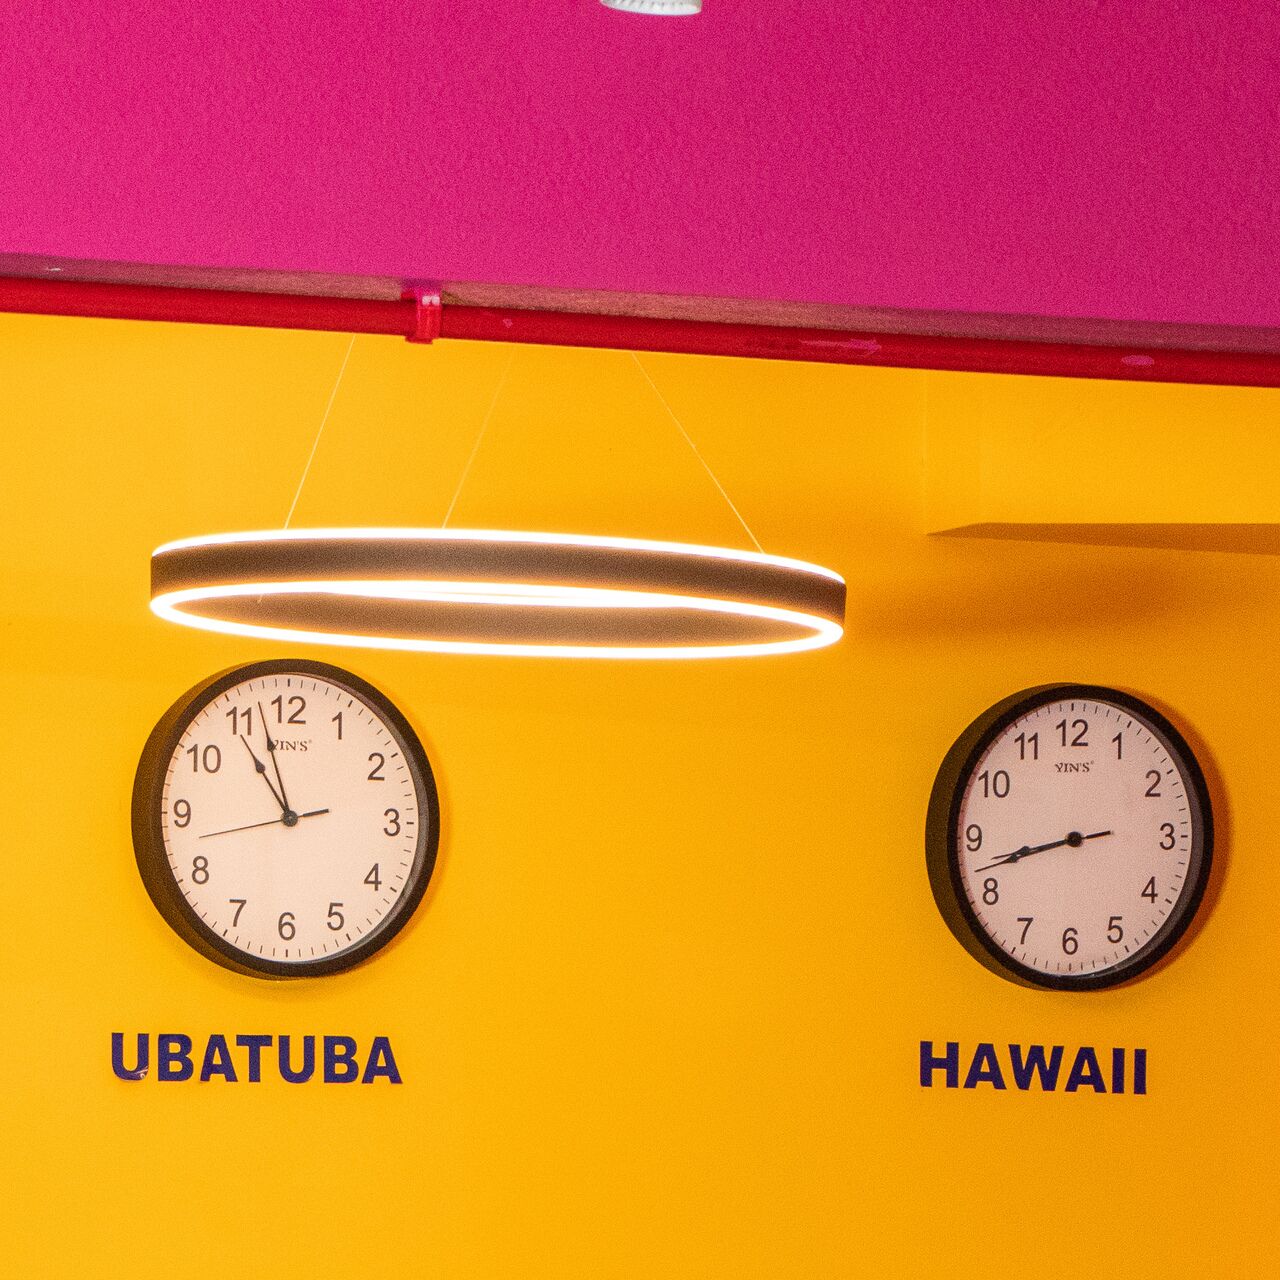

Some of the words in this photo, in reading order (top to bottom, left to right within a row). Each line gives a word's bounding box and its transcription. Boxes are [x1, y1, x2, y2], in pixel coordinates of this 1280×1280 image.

[226, 706, 252, 736] 11
[271, 695, 307, 725] 12
[332, 712, 344, 740] 1
[1055, 719, 1089, 747] 12
[187, 744, 221, 773] 10
[1014, 732, 1040, 761] 11
[1112, 732, 1123, 760] 1
[367, 753, 386, 781] 2
[978, 770, 1010, 798] 10
[1144, 770, 1162, 797] 2
[174, 799, 191, 828] 9
[383, 808, 401, 837] 3
[966, 824, 983, 852] 9
[1159, 823, 1176, 850] 3
[192, 855, 210, 885] 8
[364, 863, 383, 892] 4
[982, 878, 999, 906] 8
[1141, 877, 1158, 904] 4
[229, 899, 247, 928] 7
[278, 912, 296, 941] 6
[327, 902, 345, 931] 5
[1017, 918, 1034, 945] 7
[1062, 928, 1079, 955] 6
[1108, 916, 1124, 944] 5
[110, 1031, 404, 1085] UBATUBA
[920, 1041, 1147, 1095] HAWAII
